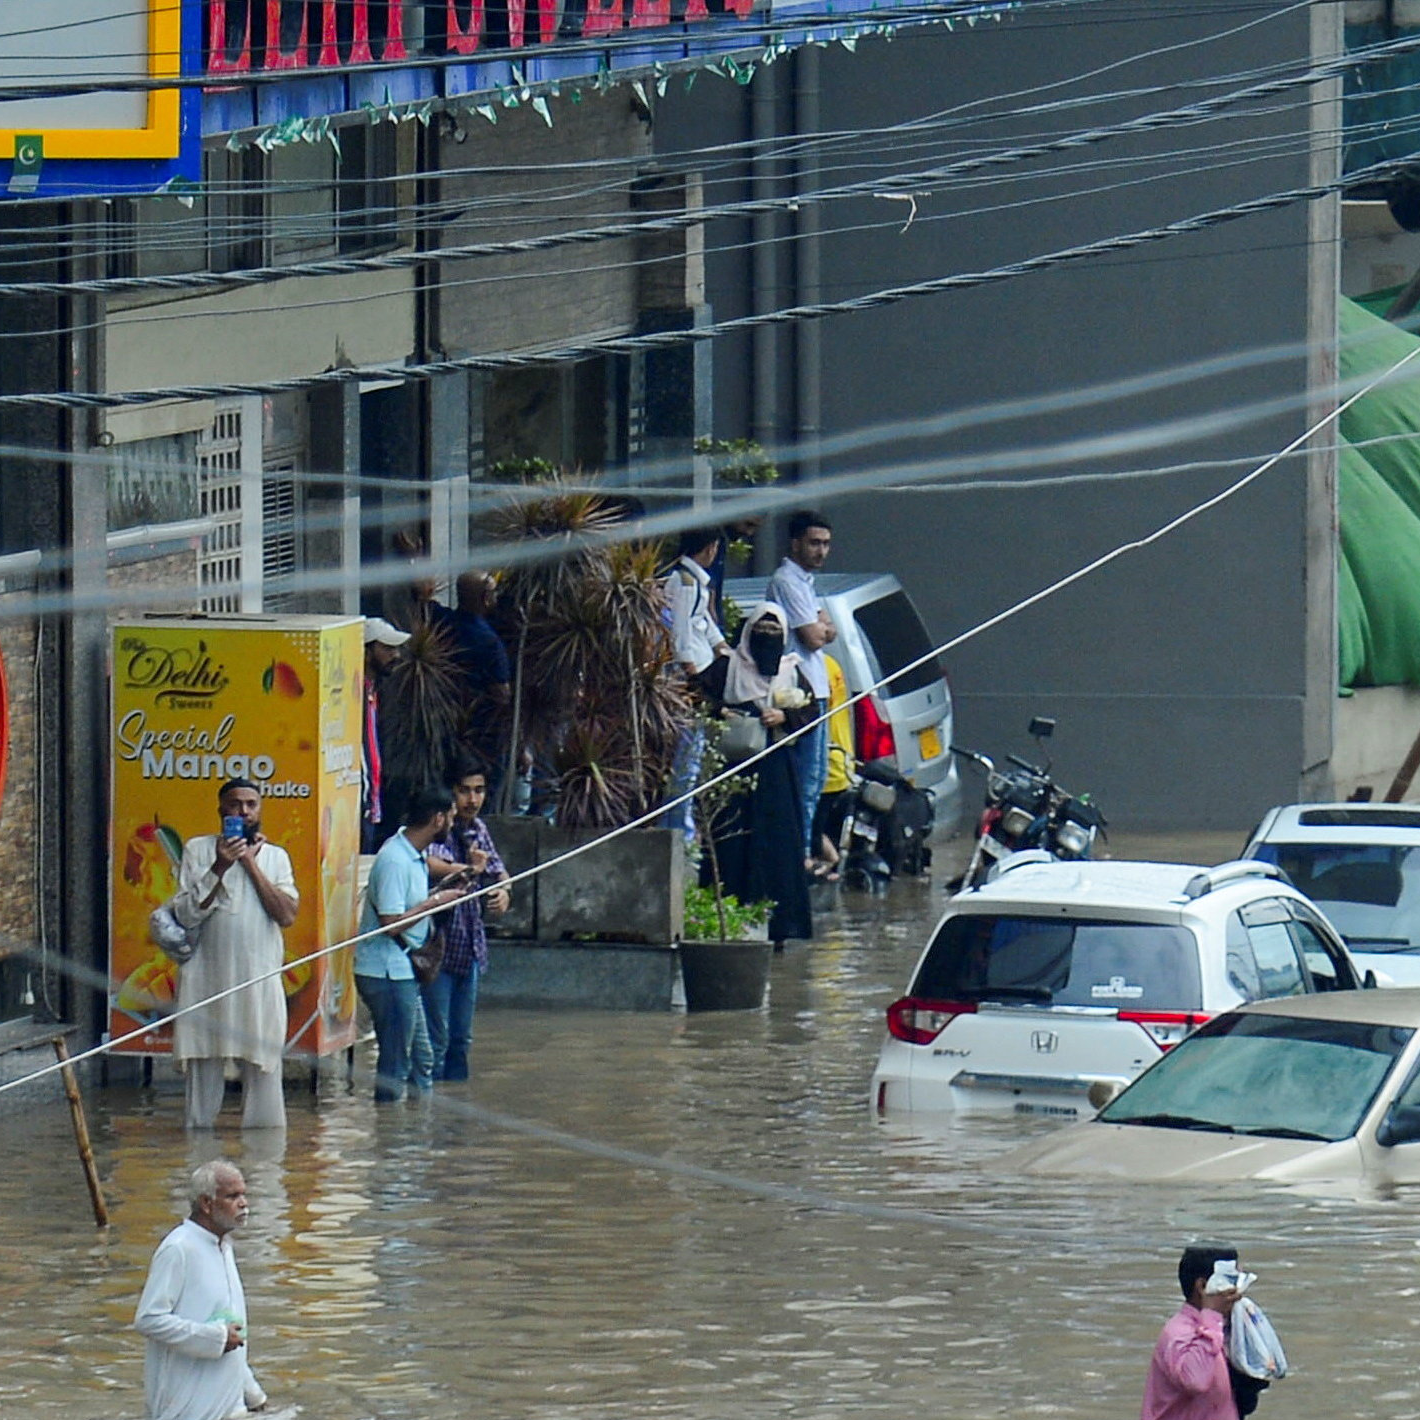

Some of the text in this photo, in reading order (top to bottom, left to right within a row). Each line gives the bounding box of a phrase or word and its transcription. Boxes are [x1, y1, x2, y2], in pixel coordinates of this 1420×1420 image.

[128, 640, 227, 688] Delhi
[117, 709, 236, 762] Special
[142, 750, 275, 780] Mango
[255, 778, 311, 799] hake
